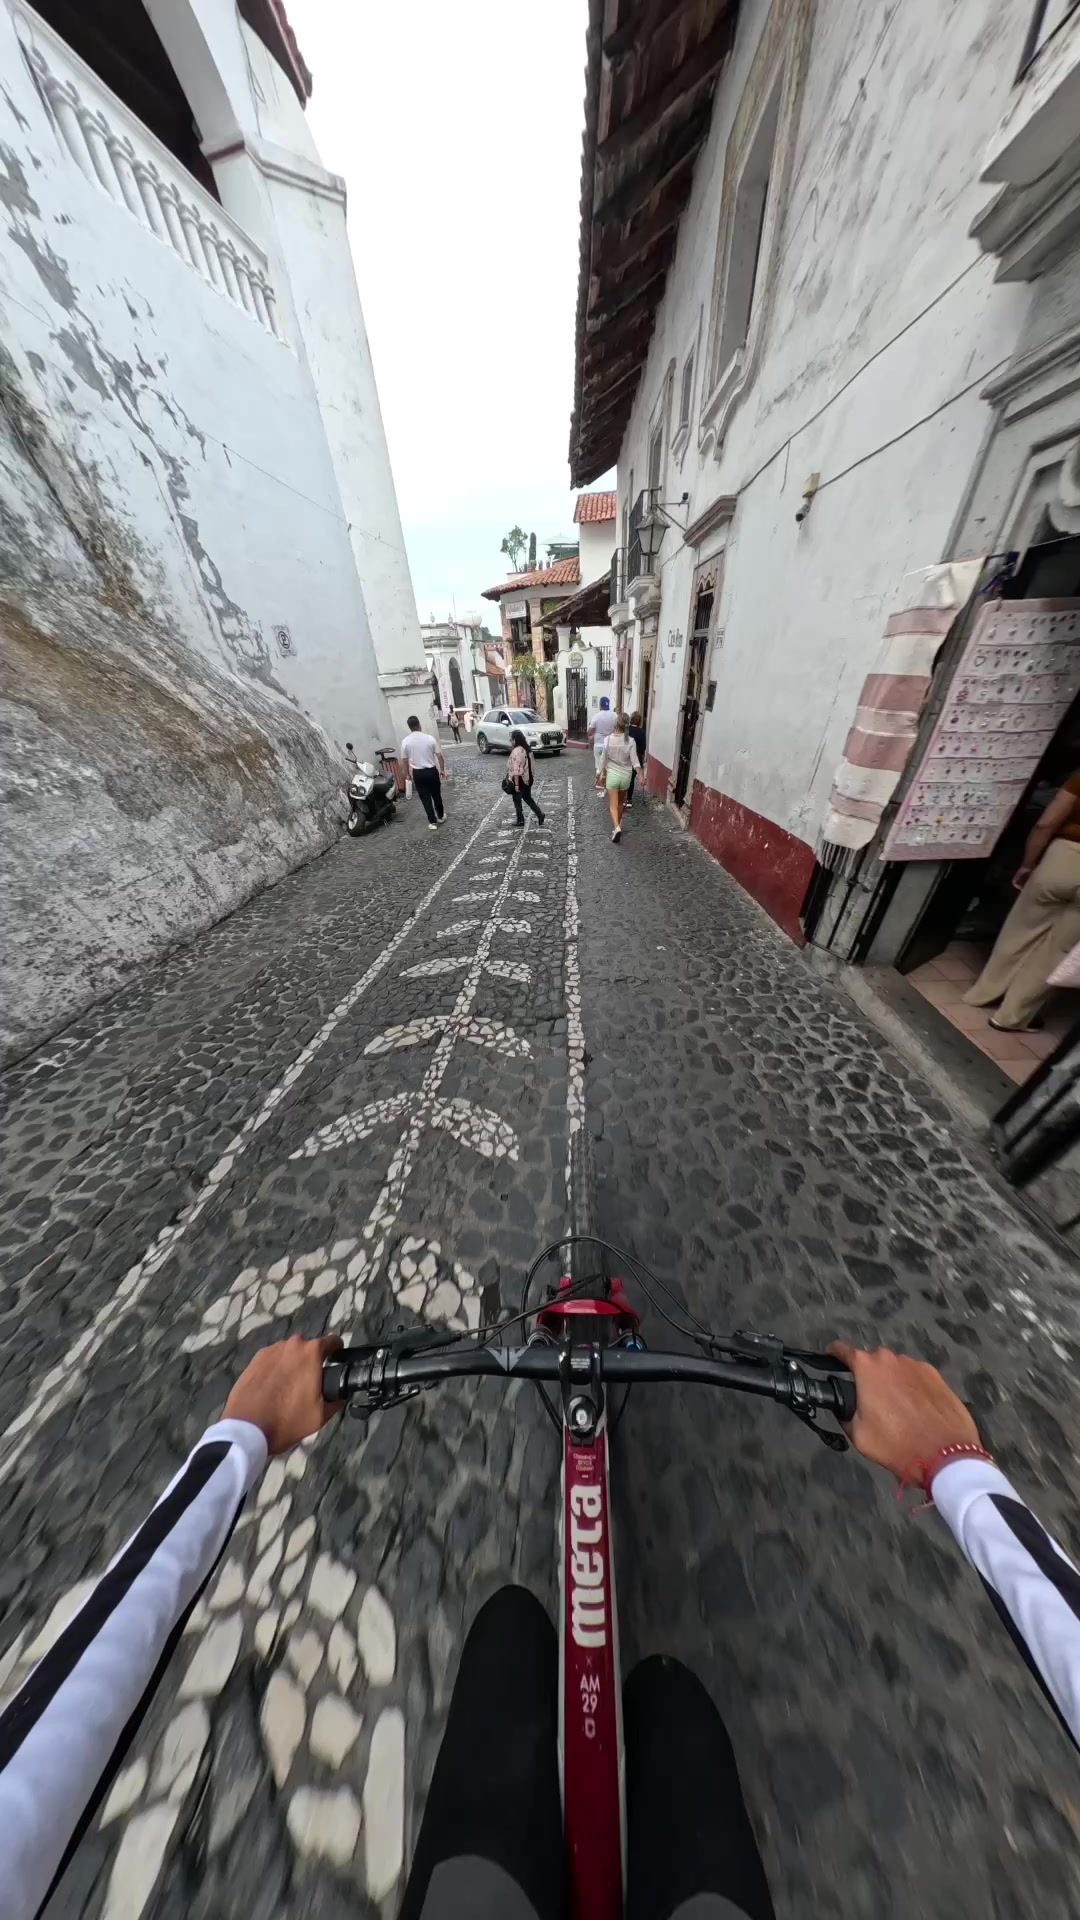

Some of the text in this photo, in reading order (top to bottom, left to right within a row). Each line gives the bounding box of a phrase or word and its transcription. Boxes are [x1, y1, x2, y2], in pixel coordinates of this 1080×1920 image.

[570, 1484, 606, 1648] meta
[580, 1673, 601, 1692] AM
[582, 1694, 598, 1713] 29
